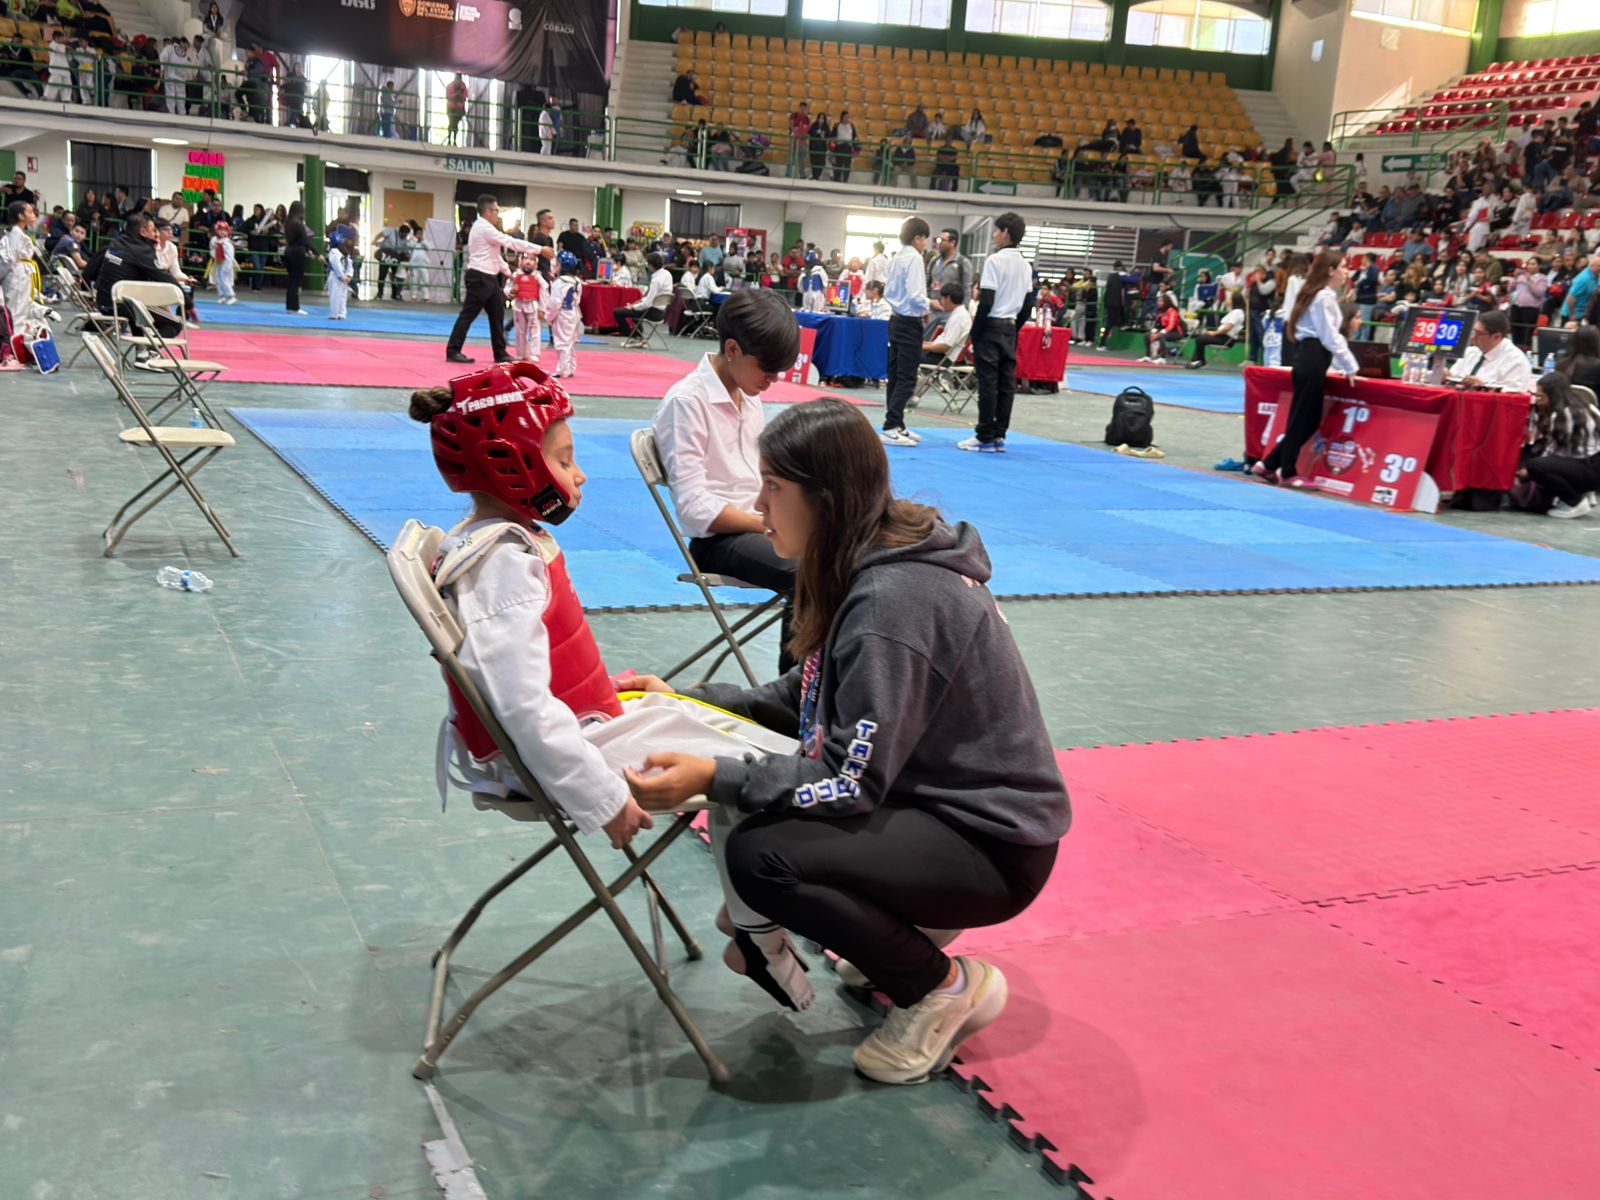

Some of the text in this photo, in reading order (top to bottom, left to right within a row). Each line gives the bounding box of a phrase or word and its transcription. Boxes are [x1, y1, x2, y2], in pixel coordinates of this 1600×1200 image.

[448, 158, 492, 174] SALIDA
[874, 195, 915, 210] SALIDA
[1415, 321, 1457, 340] 39 30
